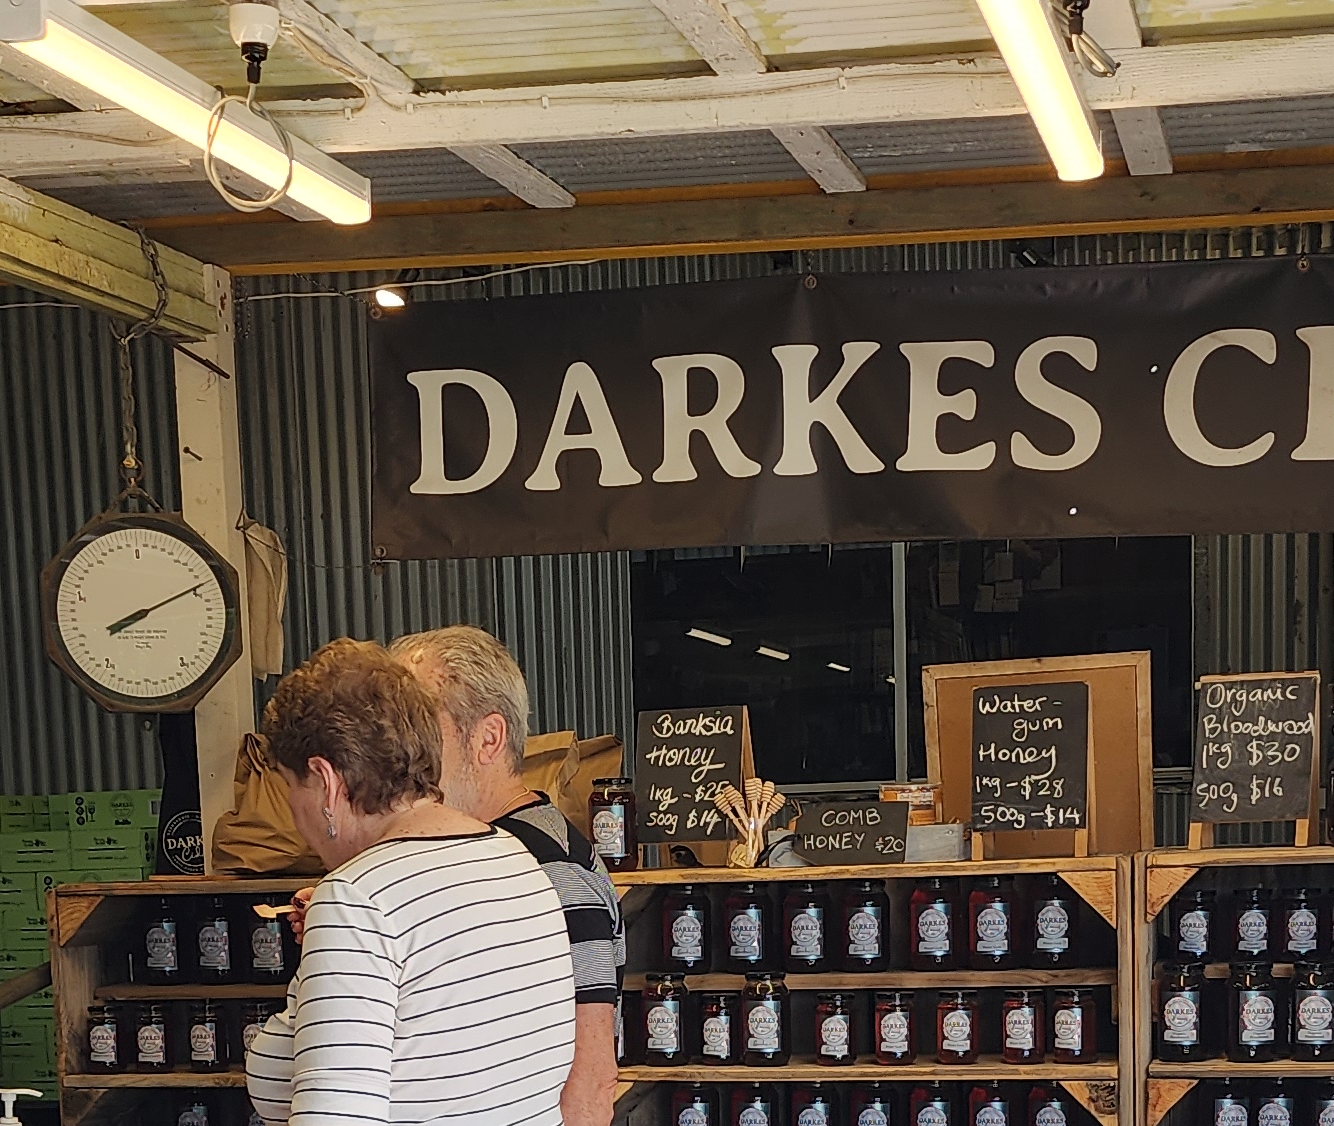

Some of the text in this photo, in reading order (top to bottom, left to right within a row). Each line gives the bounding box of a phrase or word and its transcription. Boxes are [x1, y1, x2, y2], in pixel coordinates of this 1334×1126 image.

[407, 333, 1103, 498] DARKES
[1206, 683, 1300, 717] Organic
[652, 710, 735, 738] Banksia
[1012, 717, 1064, 742] gum
[1202, 712, 1316, 739] Bloodwood
[645, 744, 727, 783] Honey
[978, 742, 1057, 781] Honey
[1202, 738, 1301, 770] 1kg $30
[649, 784, 679, 812] 1kg
[975, 775, 1001, 798] 1kg
[1196, 774, 1284, 813] 500g $16
[646, 809, 723, 836] 500g $14
[820, 807, 882, 828] COMB
[980, 804, 1026, 829] 500g
[167, 835, 204, 850] DARK
[803, 832, 906, 854] HONEY $20
[1166, 1007, 1195, 1016] DARKES
[1300, 1005, 1331, 1015] DARKES
